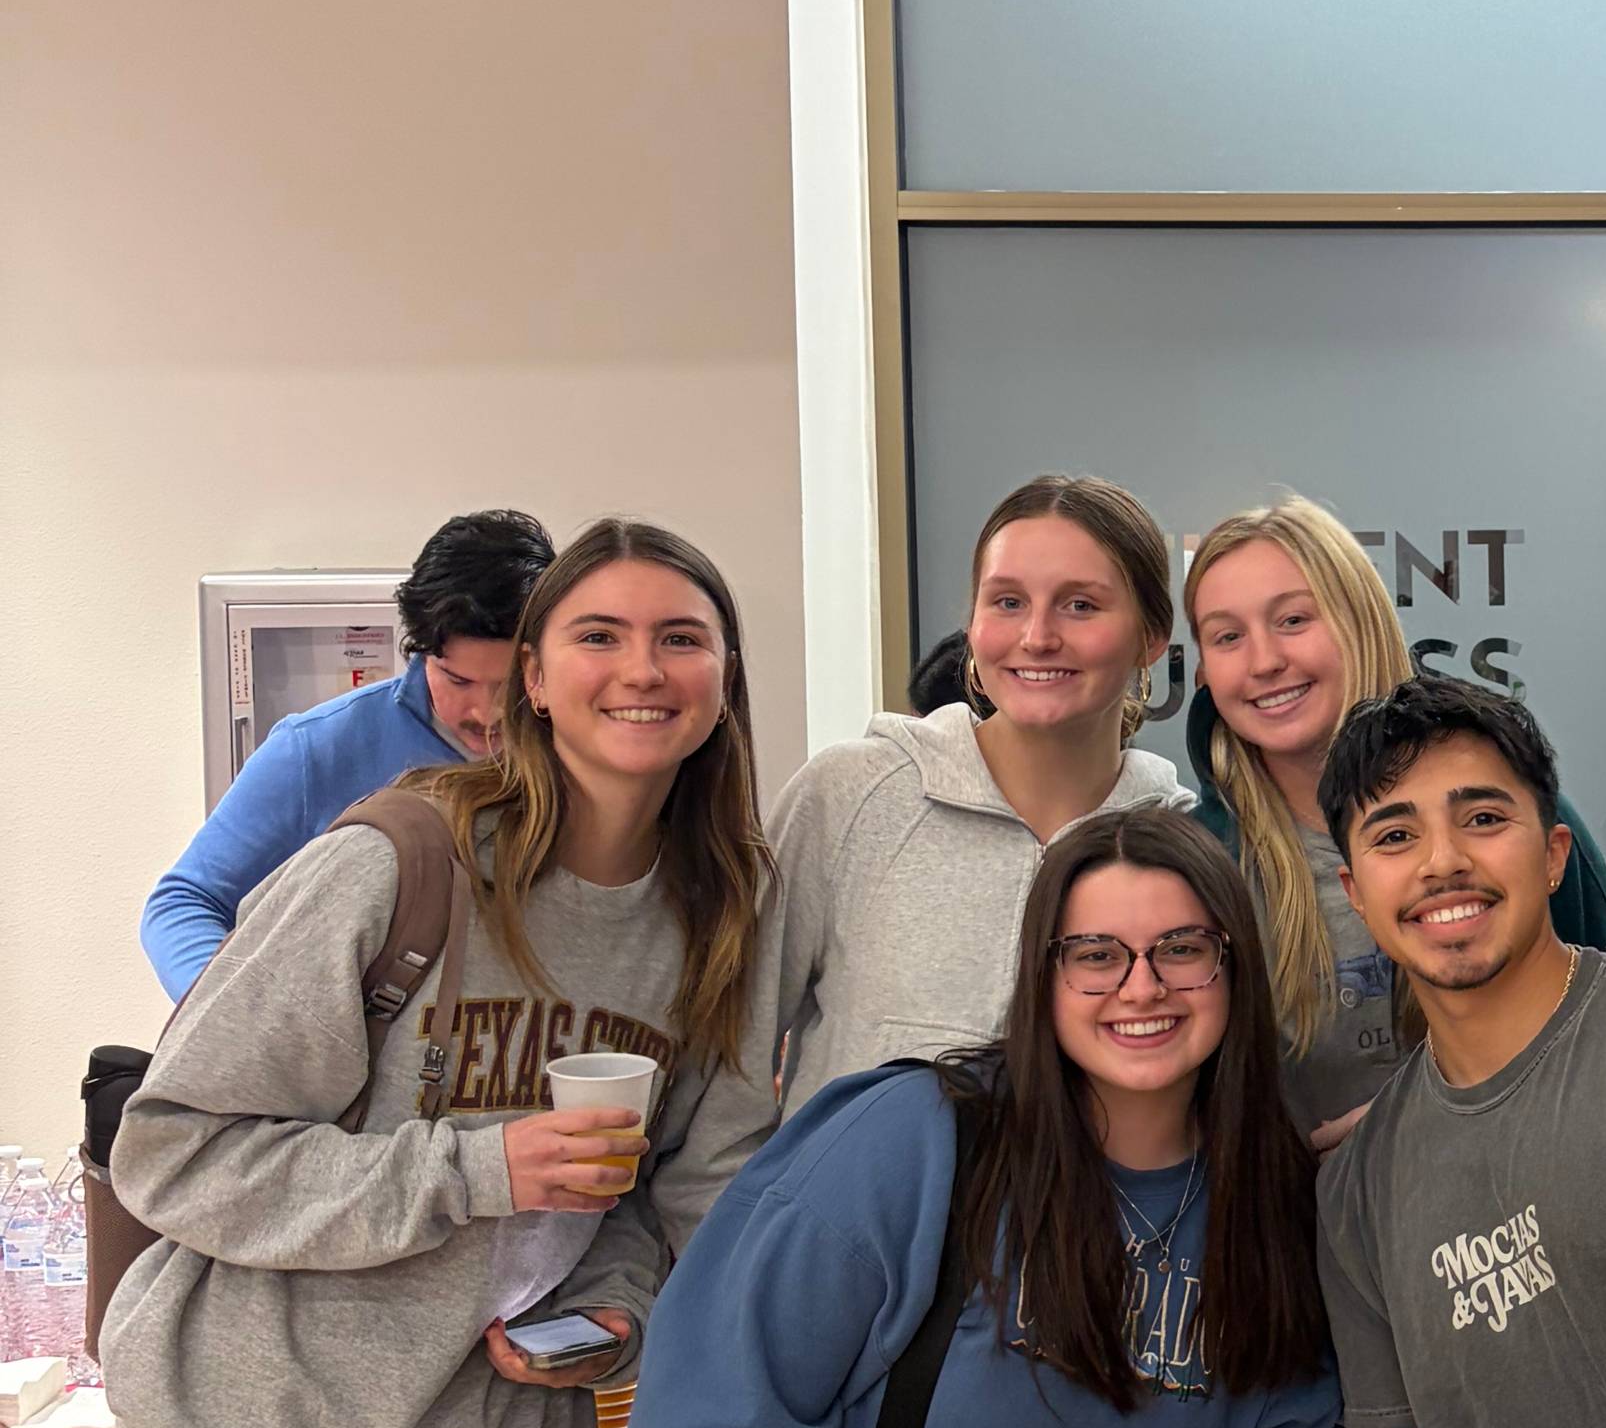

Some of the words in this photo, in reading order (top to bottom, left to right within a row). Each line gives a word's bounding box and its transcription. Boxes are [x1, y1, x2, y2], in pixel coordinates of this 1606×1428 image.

[1358, 1028, 1391, 1049] OL
[1431, 1204, 1540, 1290] MOCHAS
[1452, 1290, 1475, 1330] &
[1469, 1244, 1557, 1333] JAVAS
